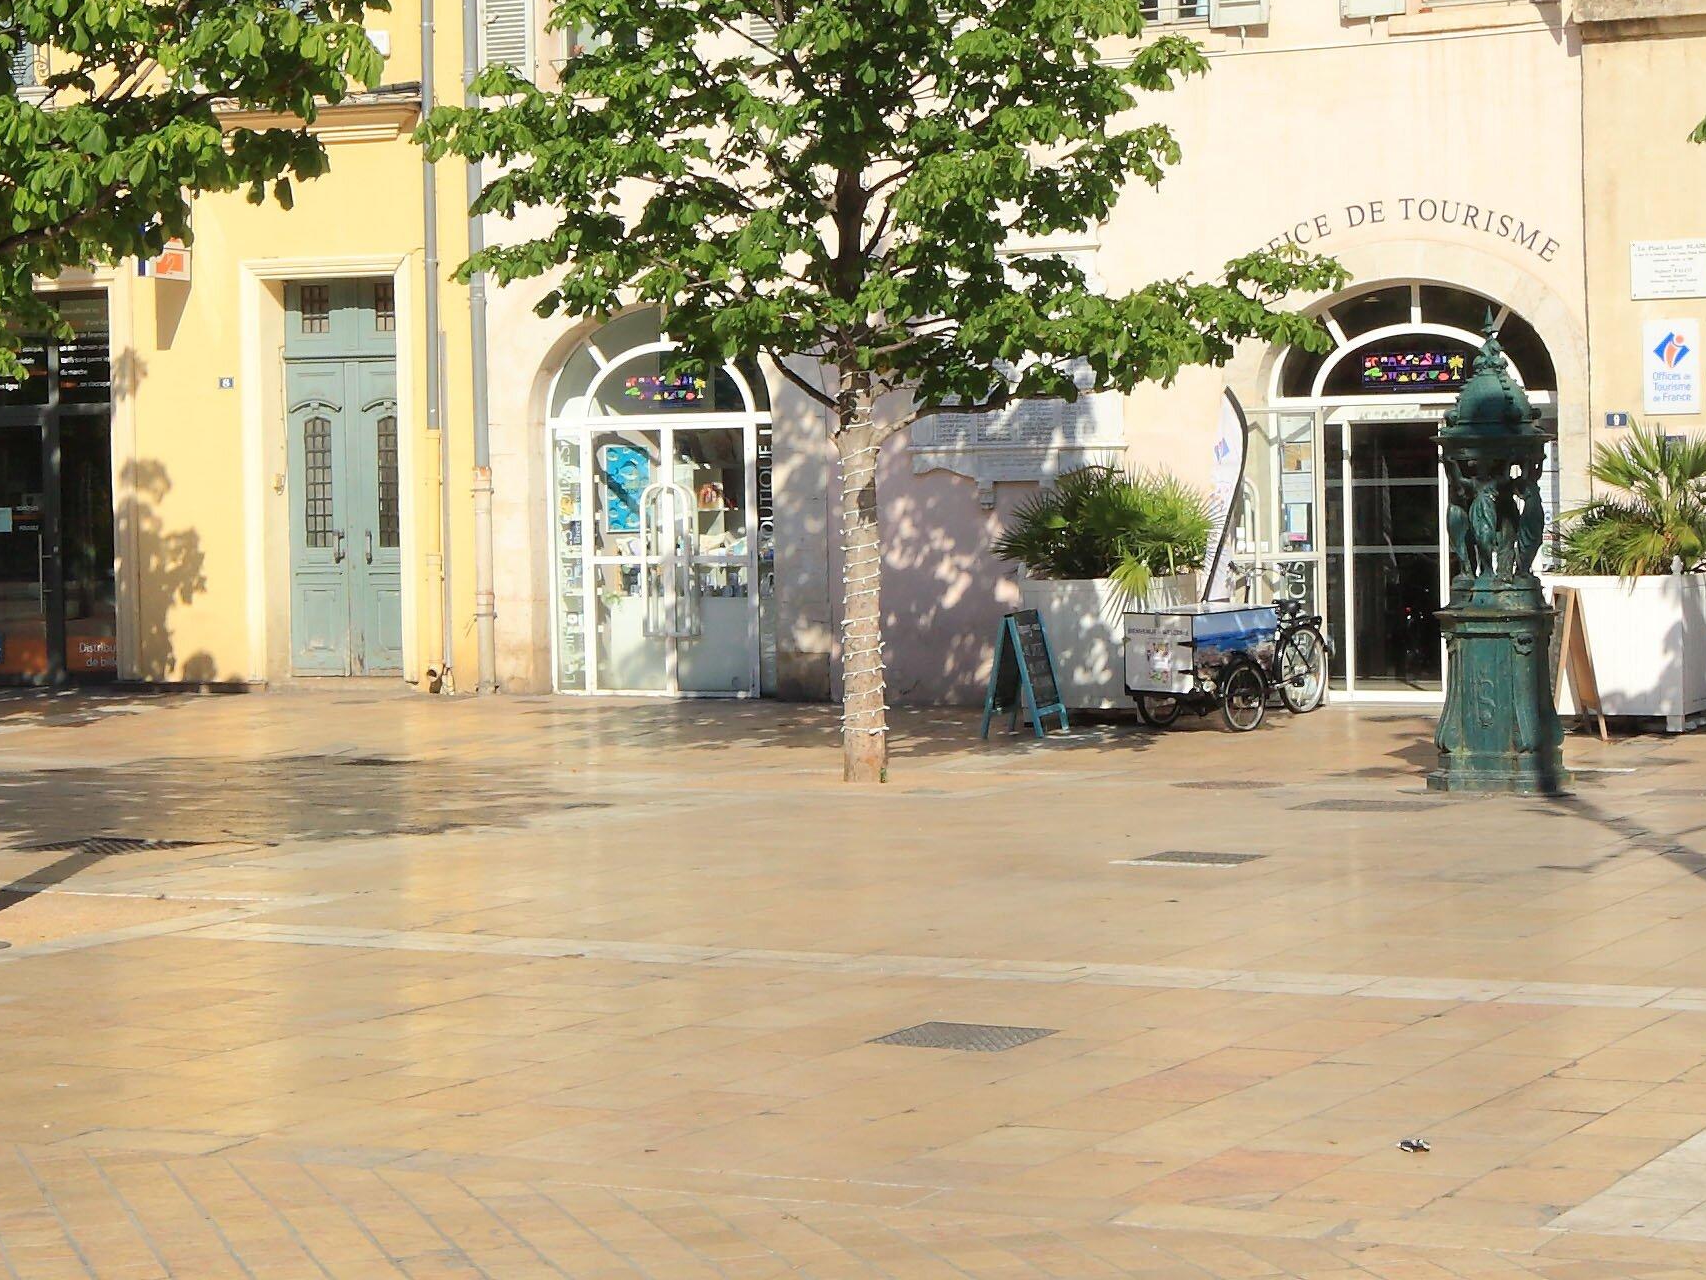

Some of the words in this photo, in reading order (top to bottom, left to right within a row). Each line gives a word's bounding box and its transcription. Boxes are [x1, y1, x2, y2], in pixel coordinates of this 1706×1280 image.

[1345, 200, 1386, 228] DE
[1398, 198, 1561, 263] TOURISME
[1652, 371, 1682, 381] Offices
[1652, 382, 1692, 392] Tourisme
[1662, 392, 1692, 402] France
[78, 641, 117, 653] Distribu
